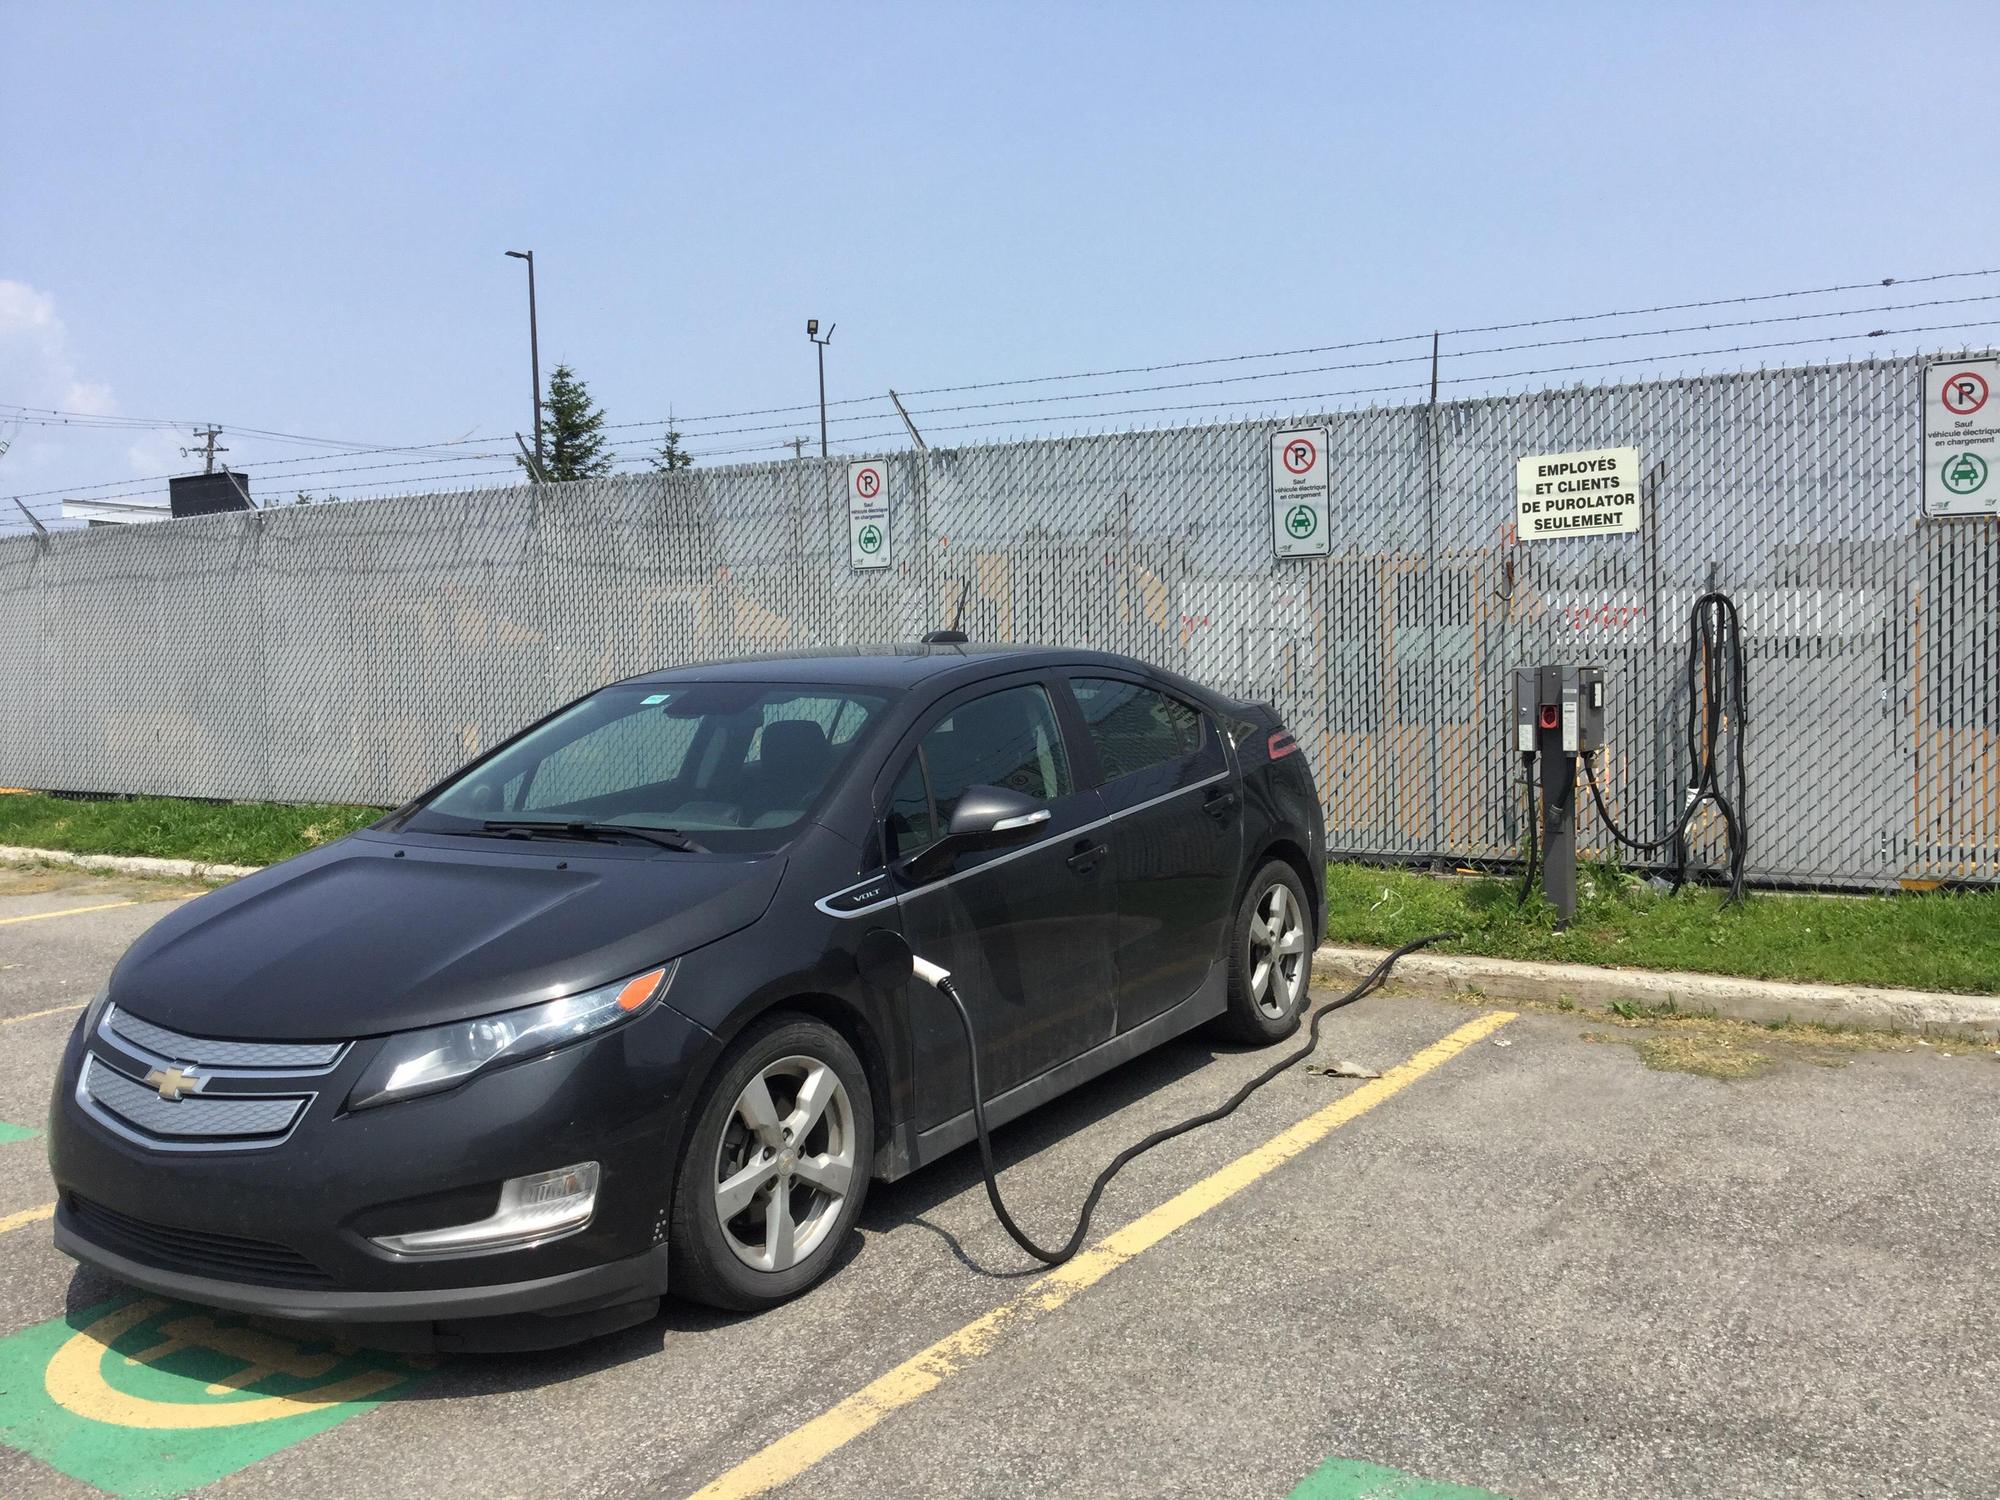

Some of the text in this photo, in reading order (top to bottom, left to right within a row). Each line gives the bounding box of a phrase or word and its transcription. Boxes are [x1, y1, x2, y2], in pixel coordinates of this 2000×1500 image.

[1958, 382, 1975, 405] P
[1954, 420, 1973, 428] Sauf
[1928, 430, 1961, 438] véhicule
[1947, 436, 1994, 446] chargement
[1295, 447, 1306, 466] P
[1538, 456, 1617, 477] EMPLOYÉS
[864, 475, 873, 491] P
[1535, 476, 1620, 495] ET CLIENTS
[1522, 493, 1635, 514] DE PUROLATOR
[1534, 512, 1623, 530] SEULEMENT
[853, 888, 880, 901] VOLT
